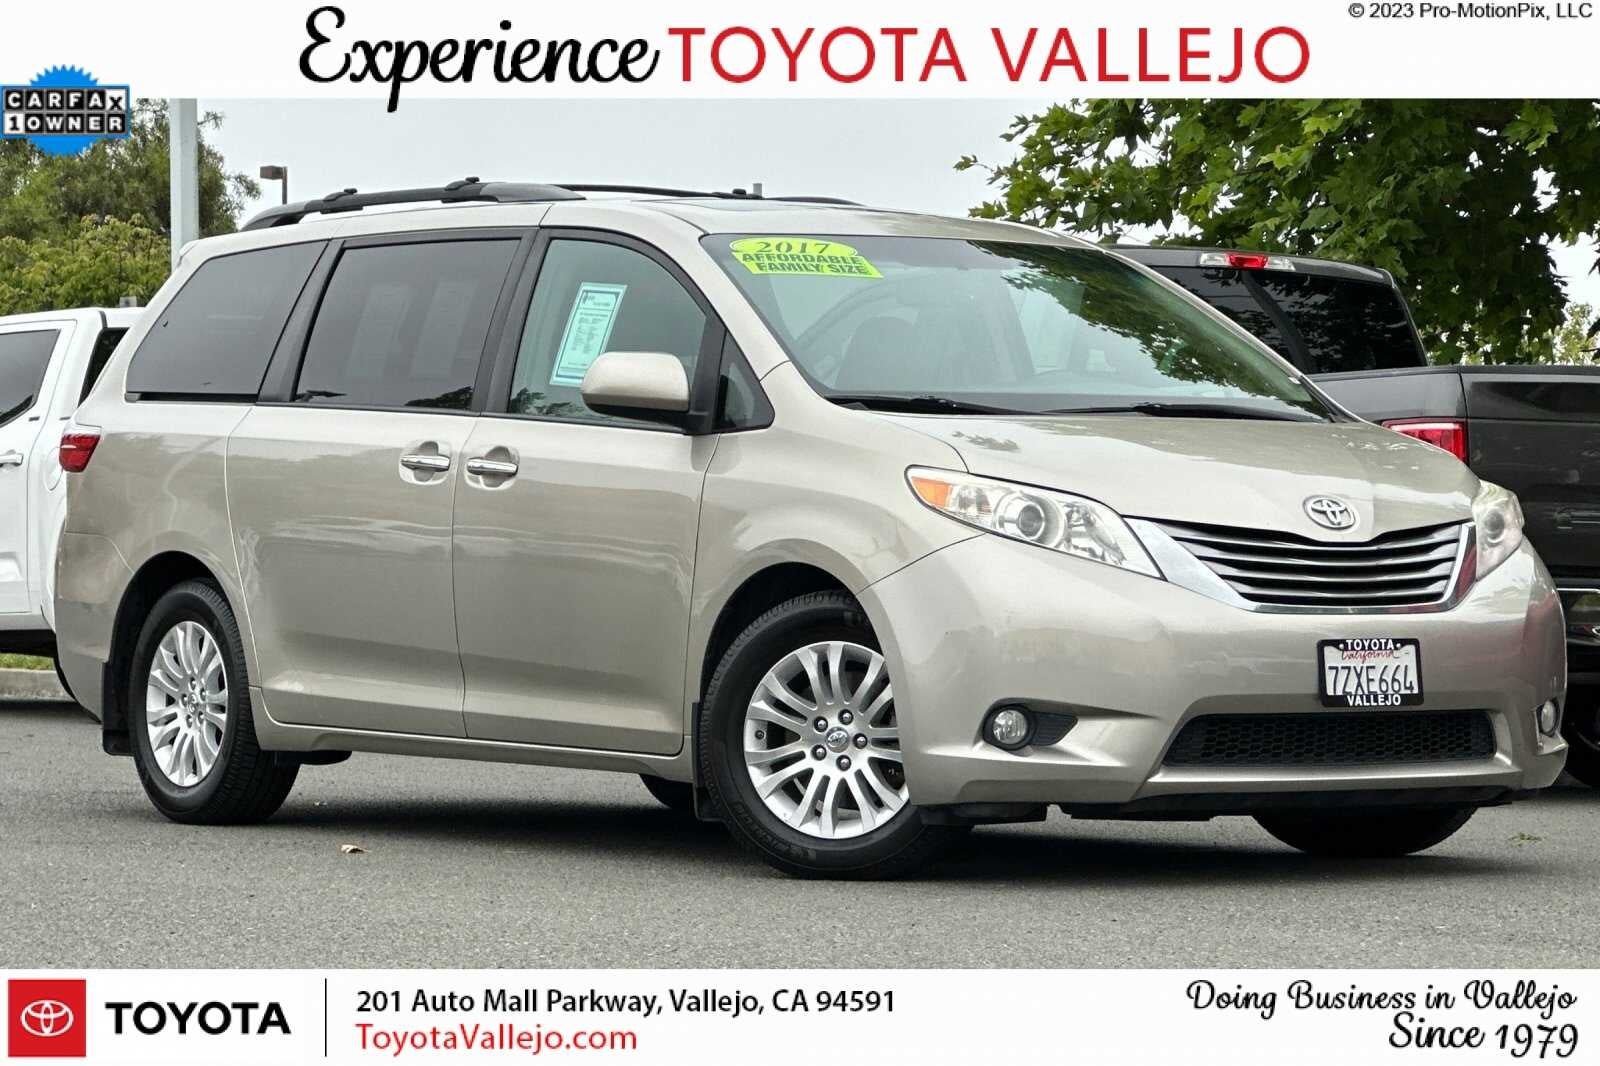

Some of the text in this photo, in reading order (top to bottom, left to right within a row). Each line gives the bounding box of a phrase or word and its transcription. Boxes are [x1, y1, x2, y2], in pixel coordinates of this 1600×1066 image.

[756, 241, 831, 254] 2017
[743, 253, 861, 265] AFFORDABLE
[757, 262, 870, 275] FAMILY SIZE
[1346, 639, 1394, 650] TOYOTA
[1328, 664, 1414, 695] 7ZXE664
[1347, 694, 1401, 706] VALLEJO
